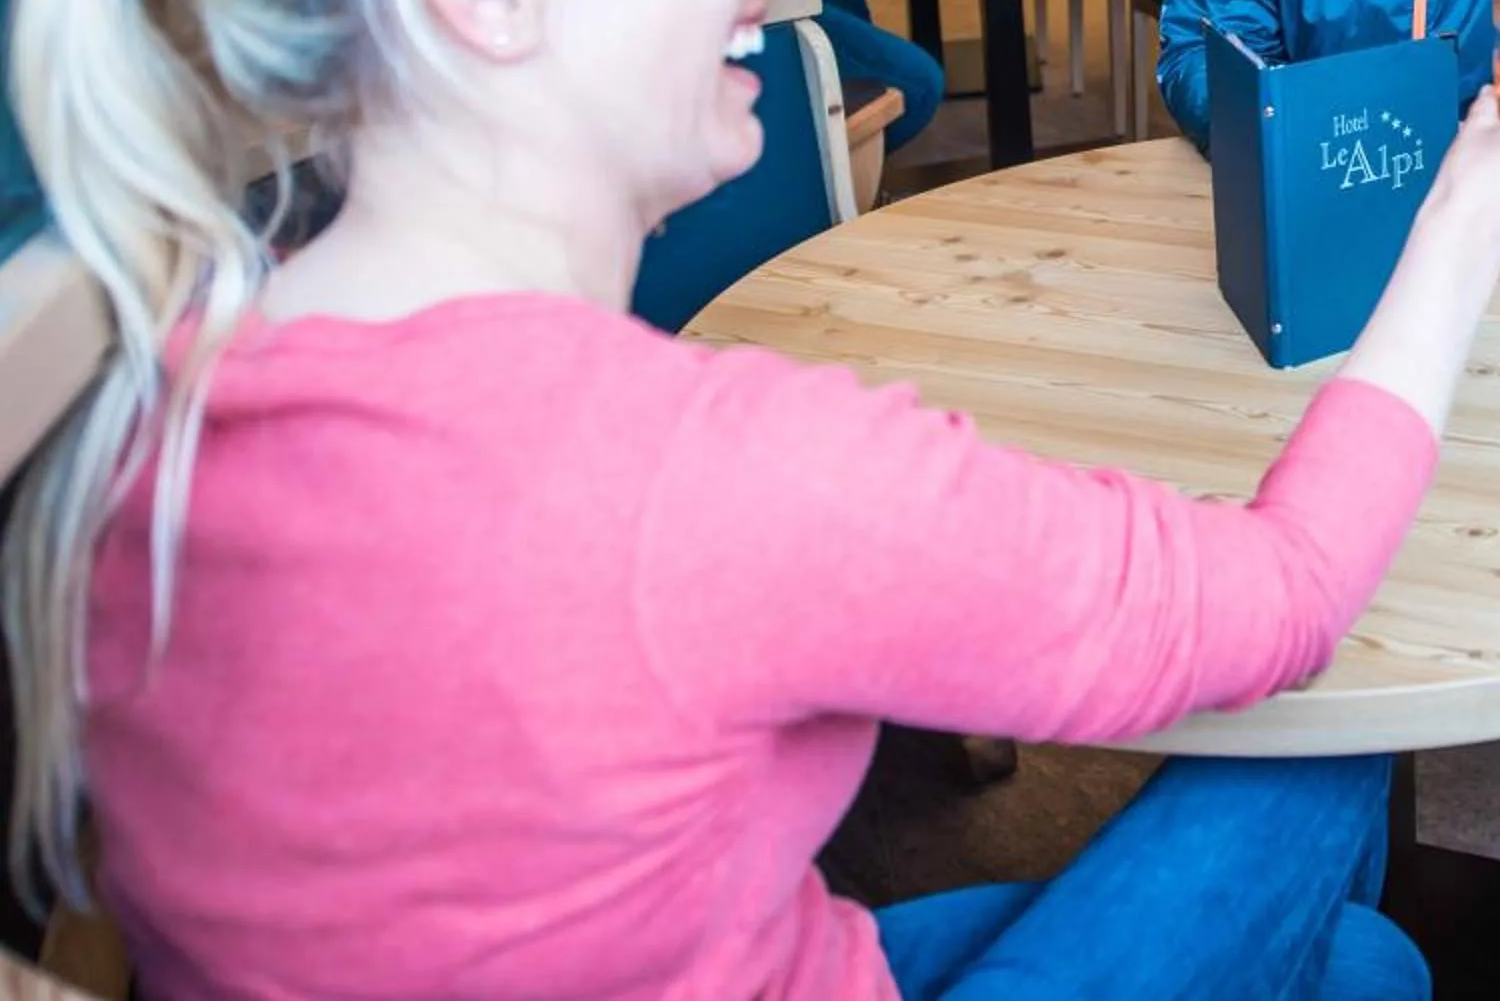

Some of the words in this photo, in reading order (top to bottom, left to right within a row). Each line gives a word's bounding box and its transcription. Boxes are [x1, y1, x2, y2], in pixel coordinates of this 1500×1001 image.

[1333, 107, 1369, 137] Hotel
[1320, 142, 1349, 170] Le
[1340, 139, 1424, 190] Alpi
